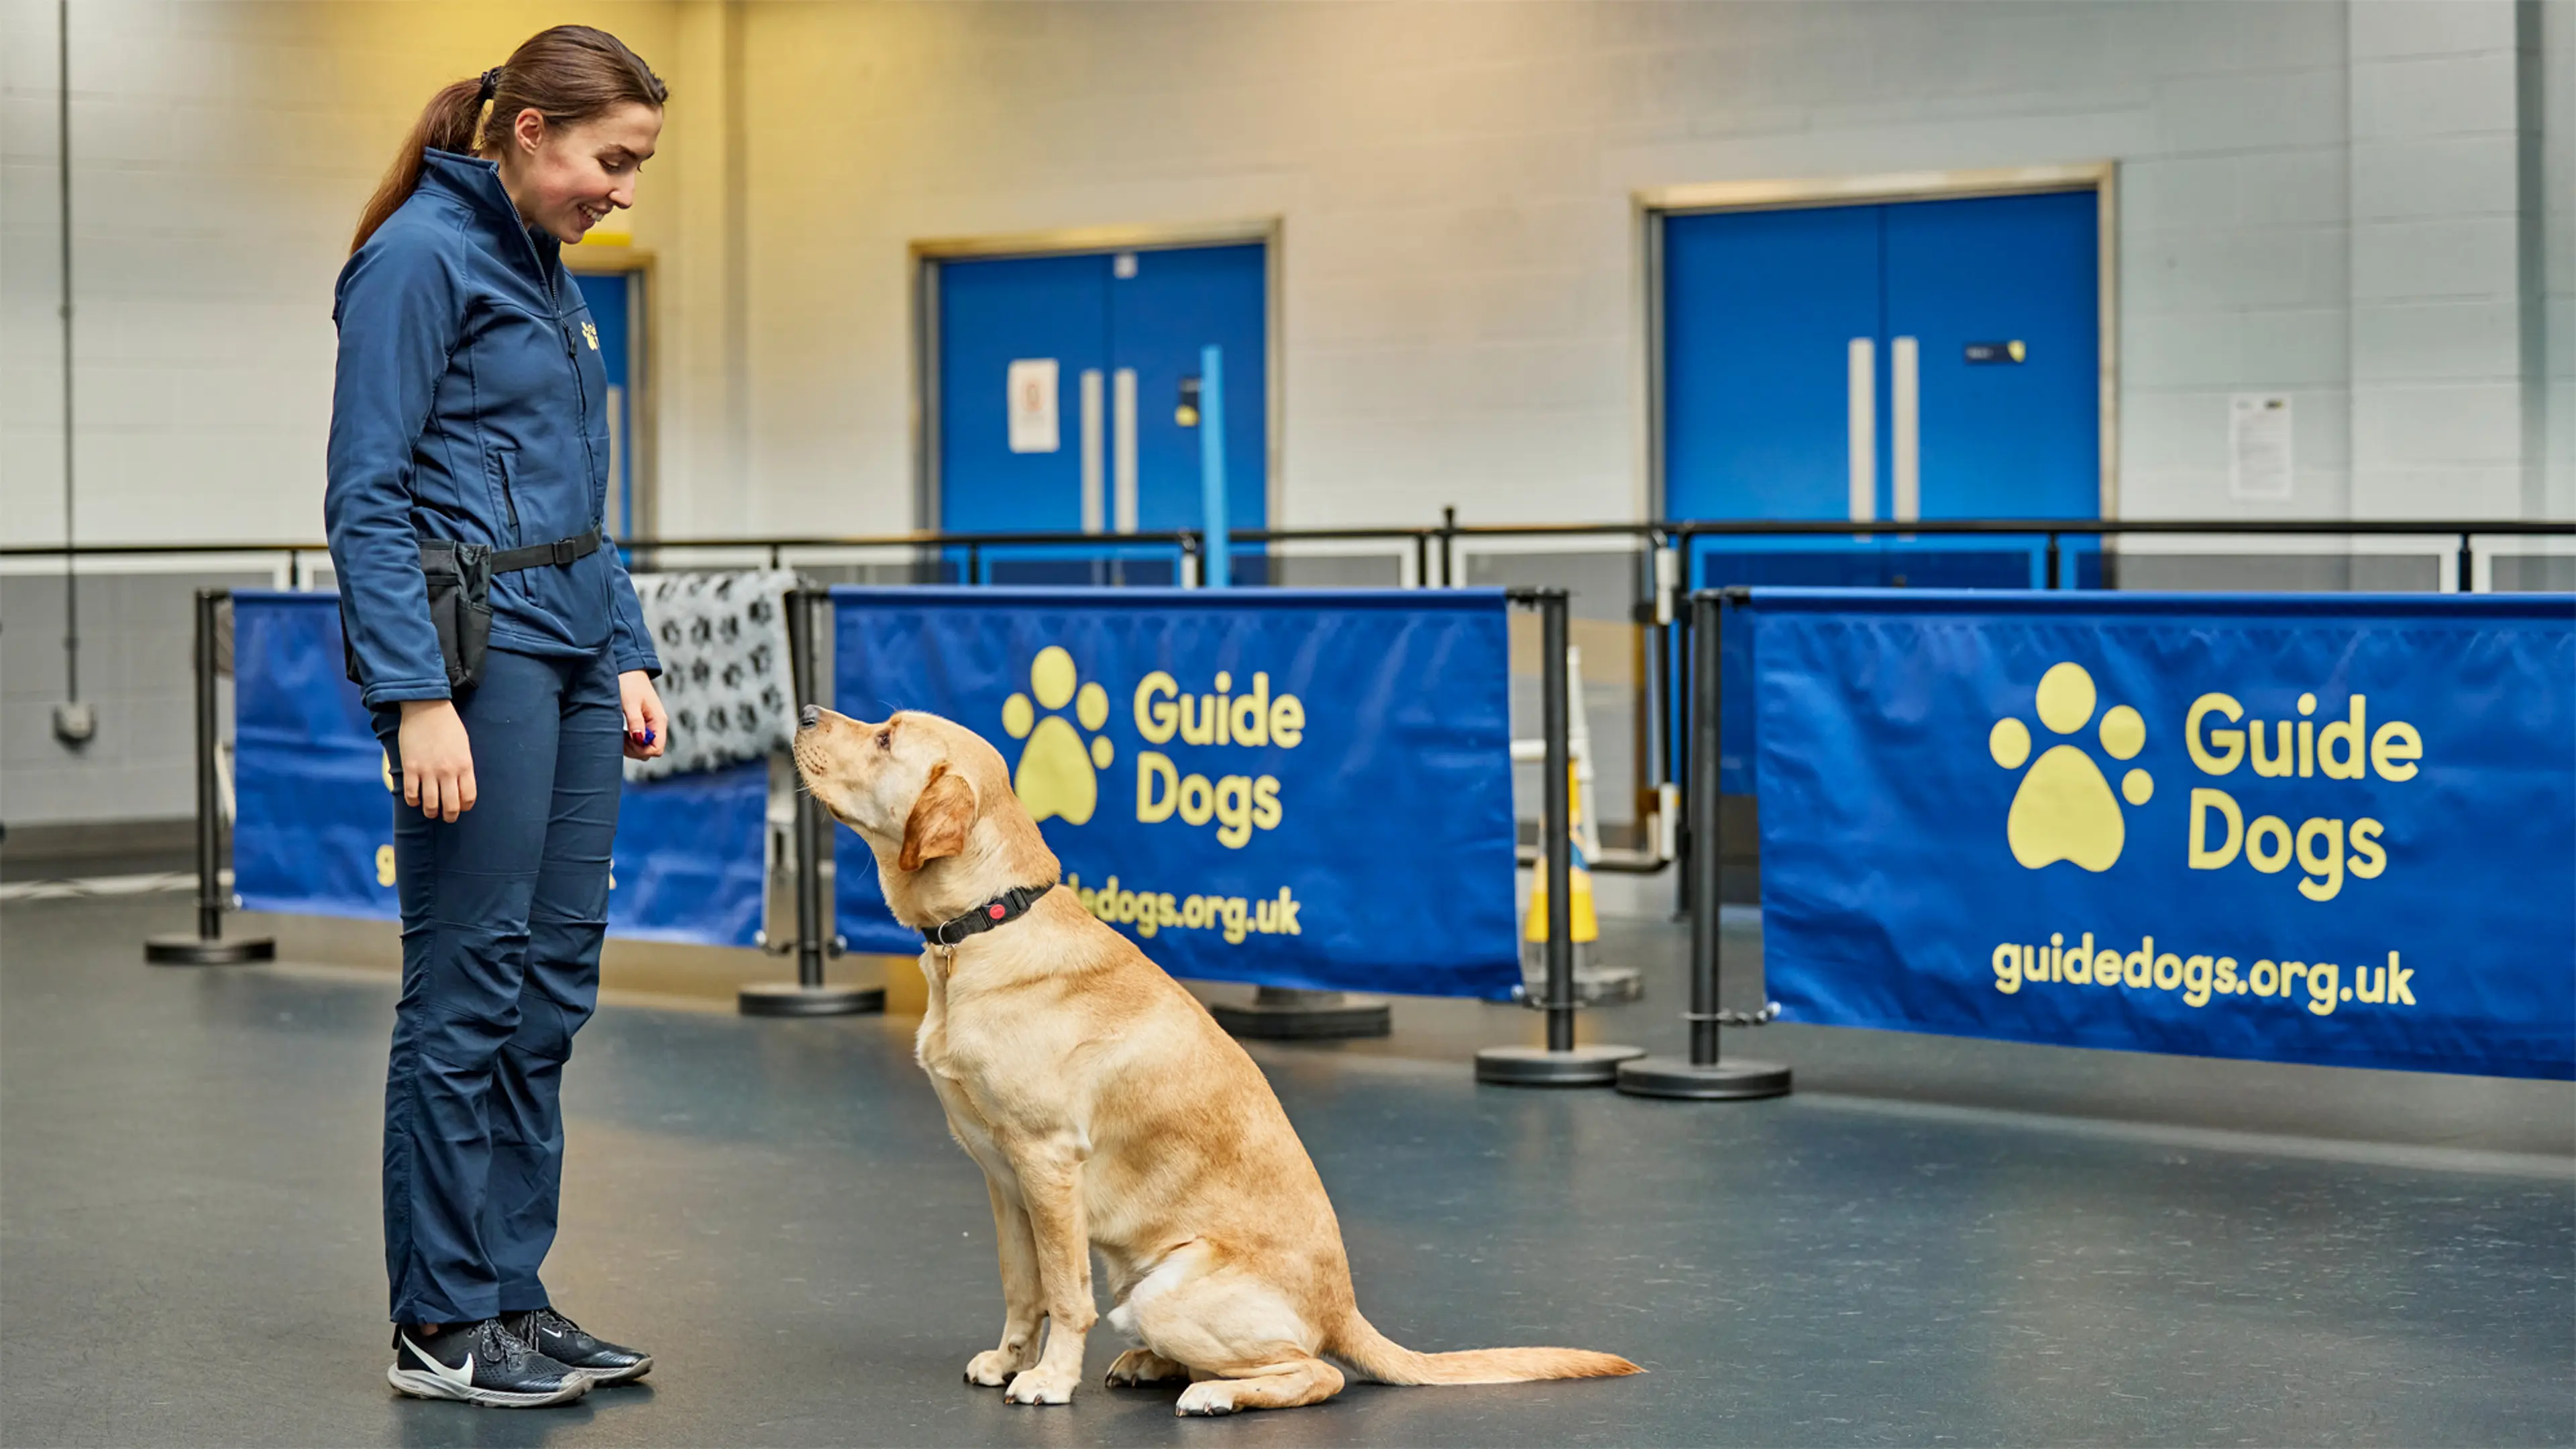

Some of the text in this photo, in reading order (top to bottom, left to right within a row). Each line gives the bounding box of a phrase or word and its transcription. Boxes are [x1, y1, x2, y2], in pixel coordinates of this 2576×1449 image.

[1134, 671, 1305, 748] Guide
[2186, 693, 2423, 782] Guide
[1136, 751, 1282, 849] Dogs
[2188, 788, 2387, 902] Dogs
[1068, 873, 1301, 945] edogs.org.uk
[1992, 932, 2416, 1016] guidedogs.org.uk
